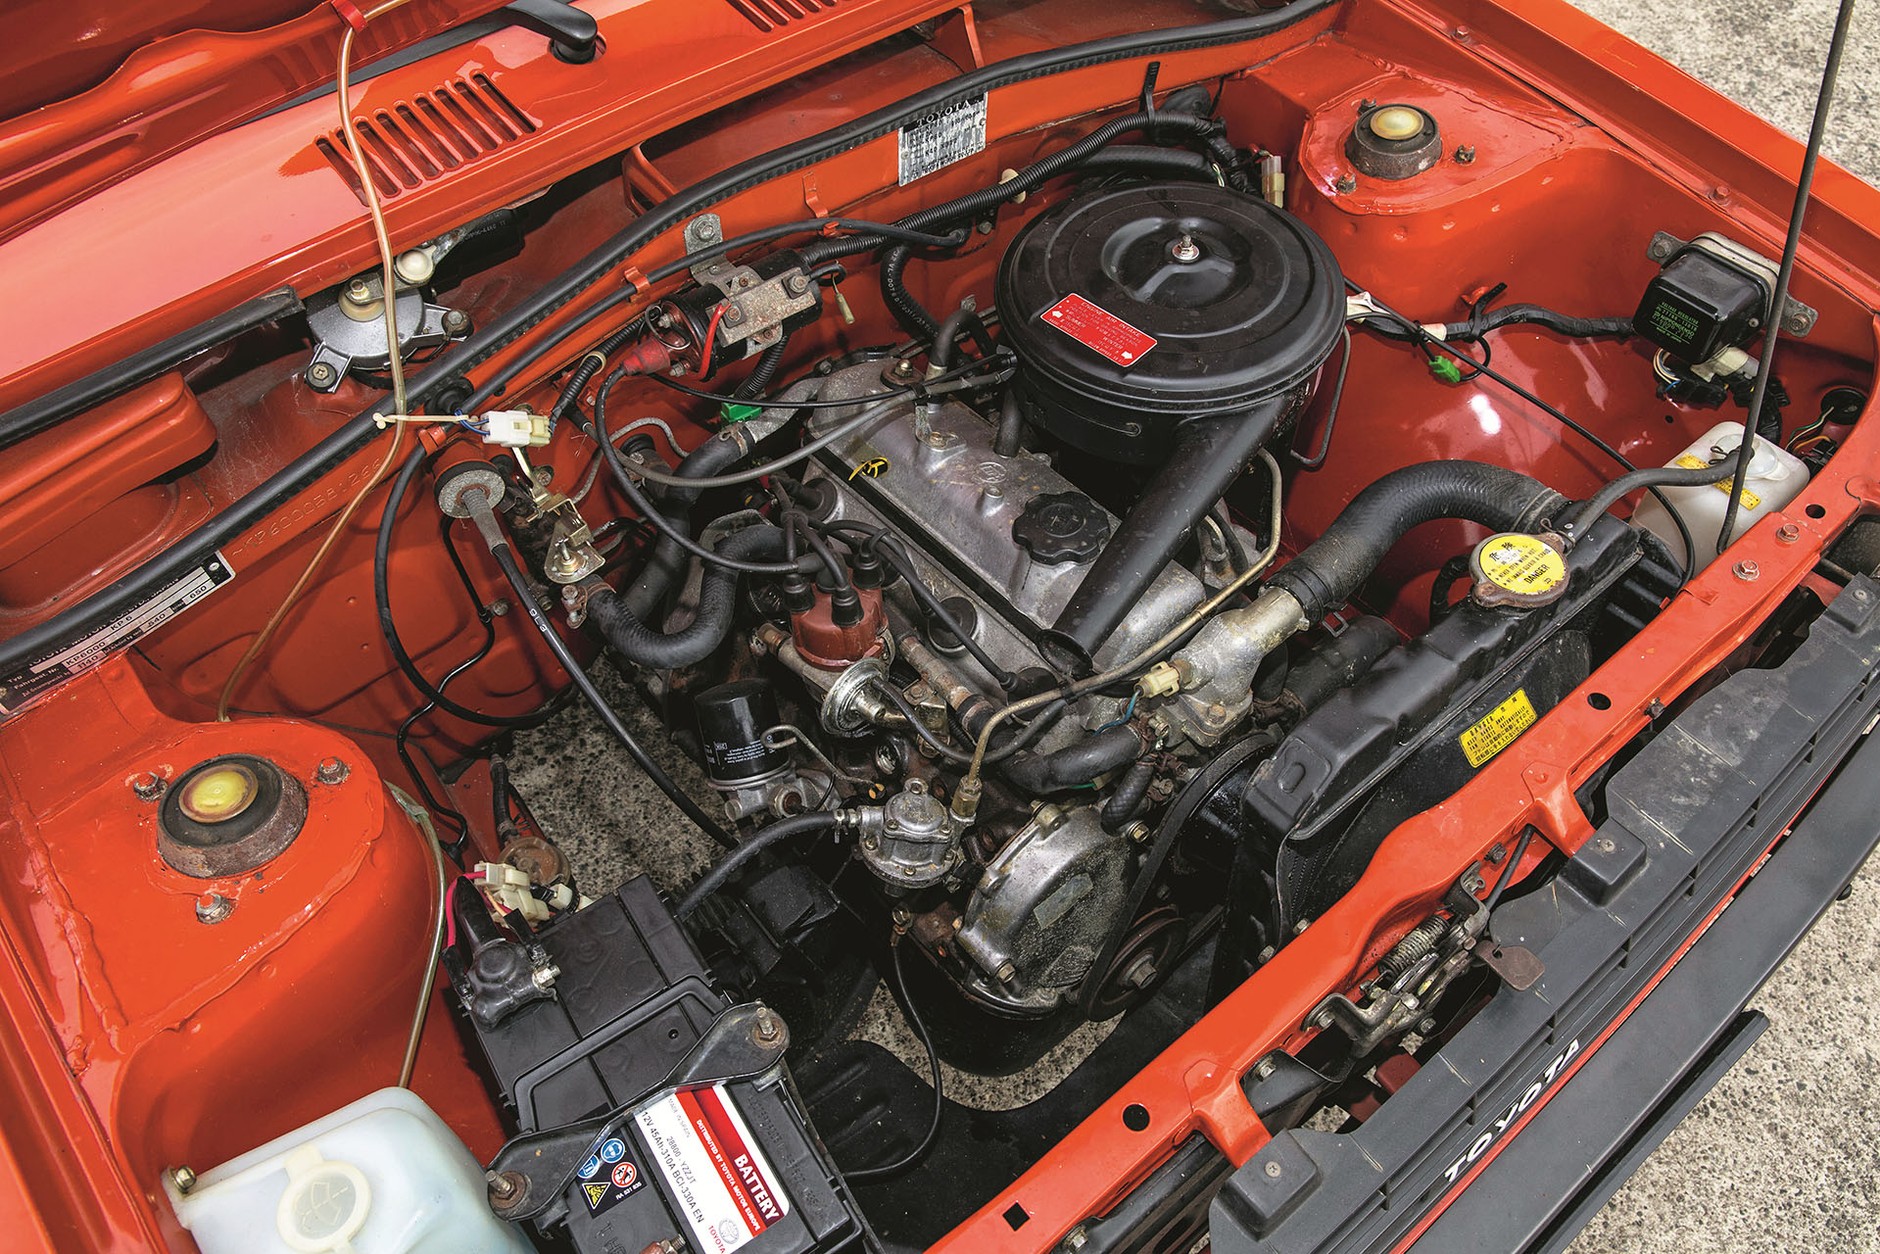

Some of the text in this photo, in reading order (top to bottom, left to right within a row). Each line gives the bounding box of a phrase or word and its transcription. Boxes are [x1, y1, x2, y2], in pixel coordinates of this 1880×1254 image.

[917, 100, 971, 126] TOYOTA
[1524, 564, 1550, 584] DANGER
[189, 585, 208, 600] 650
[7, 615, 133, 685] Typ KP 6
[66, 641, 106, 666] KP6000
[77, 654, 100, 670] 1140
[1469, 743, 1479, 751] FAN
[1500, 705, 1526, 729] AUTOMATICALLY
[1470, 715, 1494, 737] DANGER
[1495, 715, 1506, 725] AWAY
[1444, 1039, 1580, 1182] TOYOTA
[667, 1136, 681, 1158] 28800
[640, 1110, 704, 1223] 12V 45Ah-310A BCI-330A EN
[696, 1119, 760, 1231] DISTRIBUTED BY TOYOTA MOTOR EUROPE
[734, 1153, 780, 1220] BATTERY
[708, 1225, 726, 1253] TOYOTA
